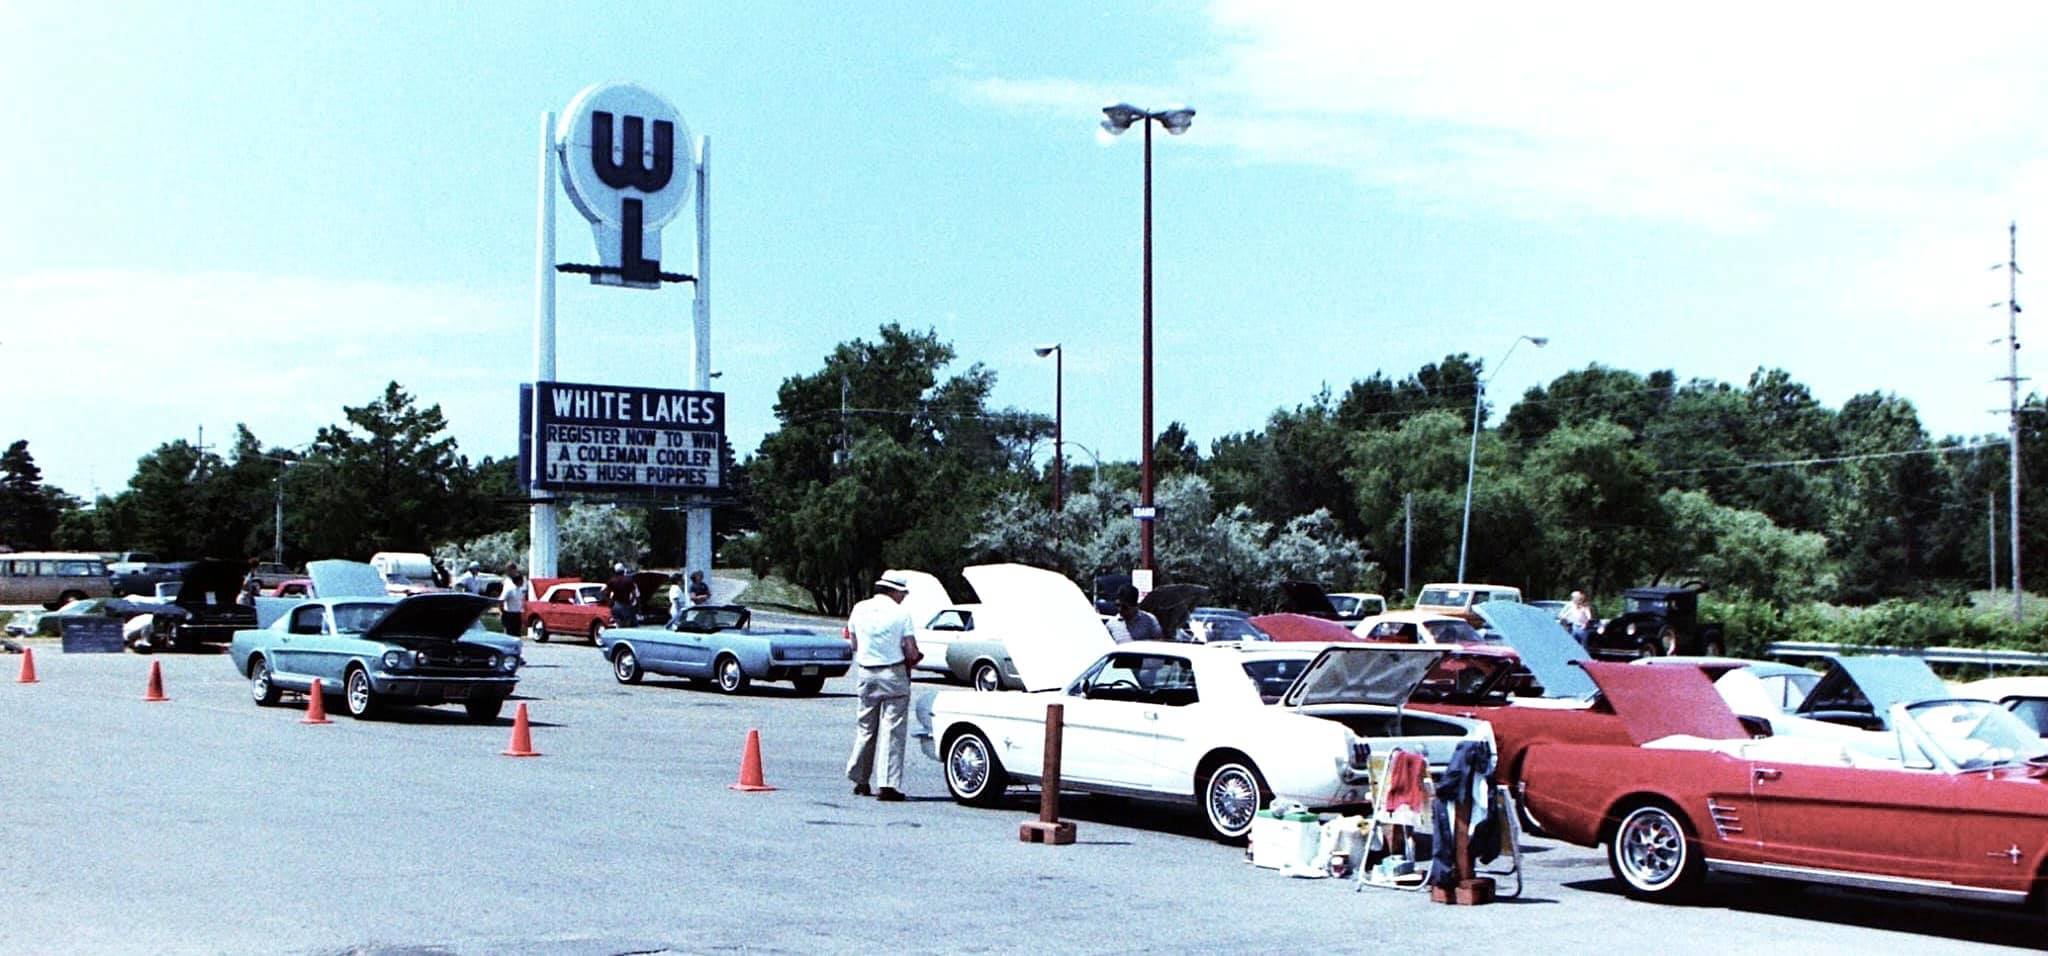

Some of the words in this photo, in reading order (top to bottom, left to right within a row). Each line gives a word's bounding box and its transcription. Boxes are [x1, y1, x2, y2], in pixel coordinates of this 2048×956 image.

[592, 111, 674, 193] W
[621, 197, 660, 284] L
[552, 388, 632, 420] WHITE
[642, 393, 715, 424] LAKES
[547, 426, 620, 444] REGISTER
[626, 431, 657, 446] NOW
[664, 432, 684, 447] TO
[692, 434, 717, 449] WIN
[559, 445, 571, 461] A
[577, 446, 648, 463] COLEMAN
[656, 449, 711, 467] COOLER
[548, 464, 558, 480] J
[597, 466, 637, 483] HUSH
[646, 468, 708, 485] PUPPIES
